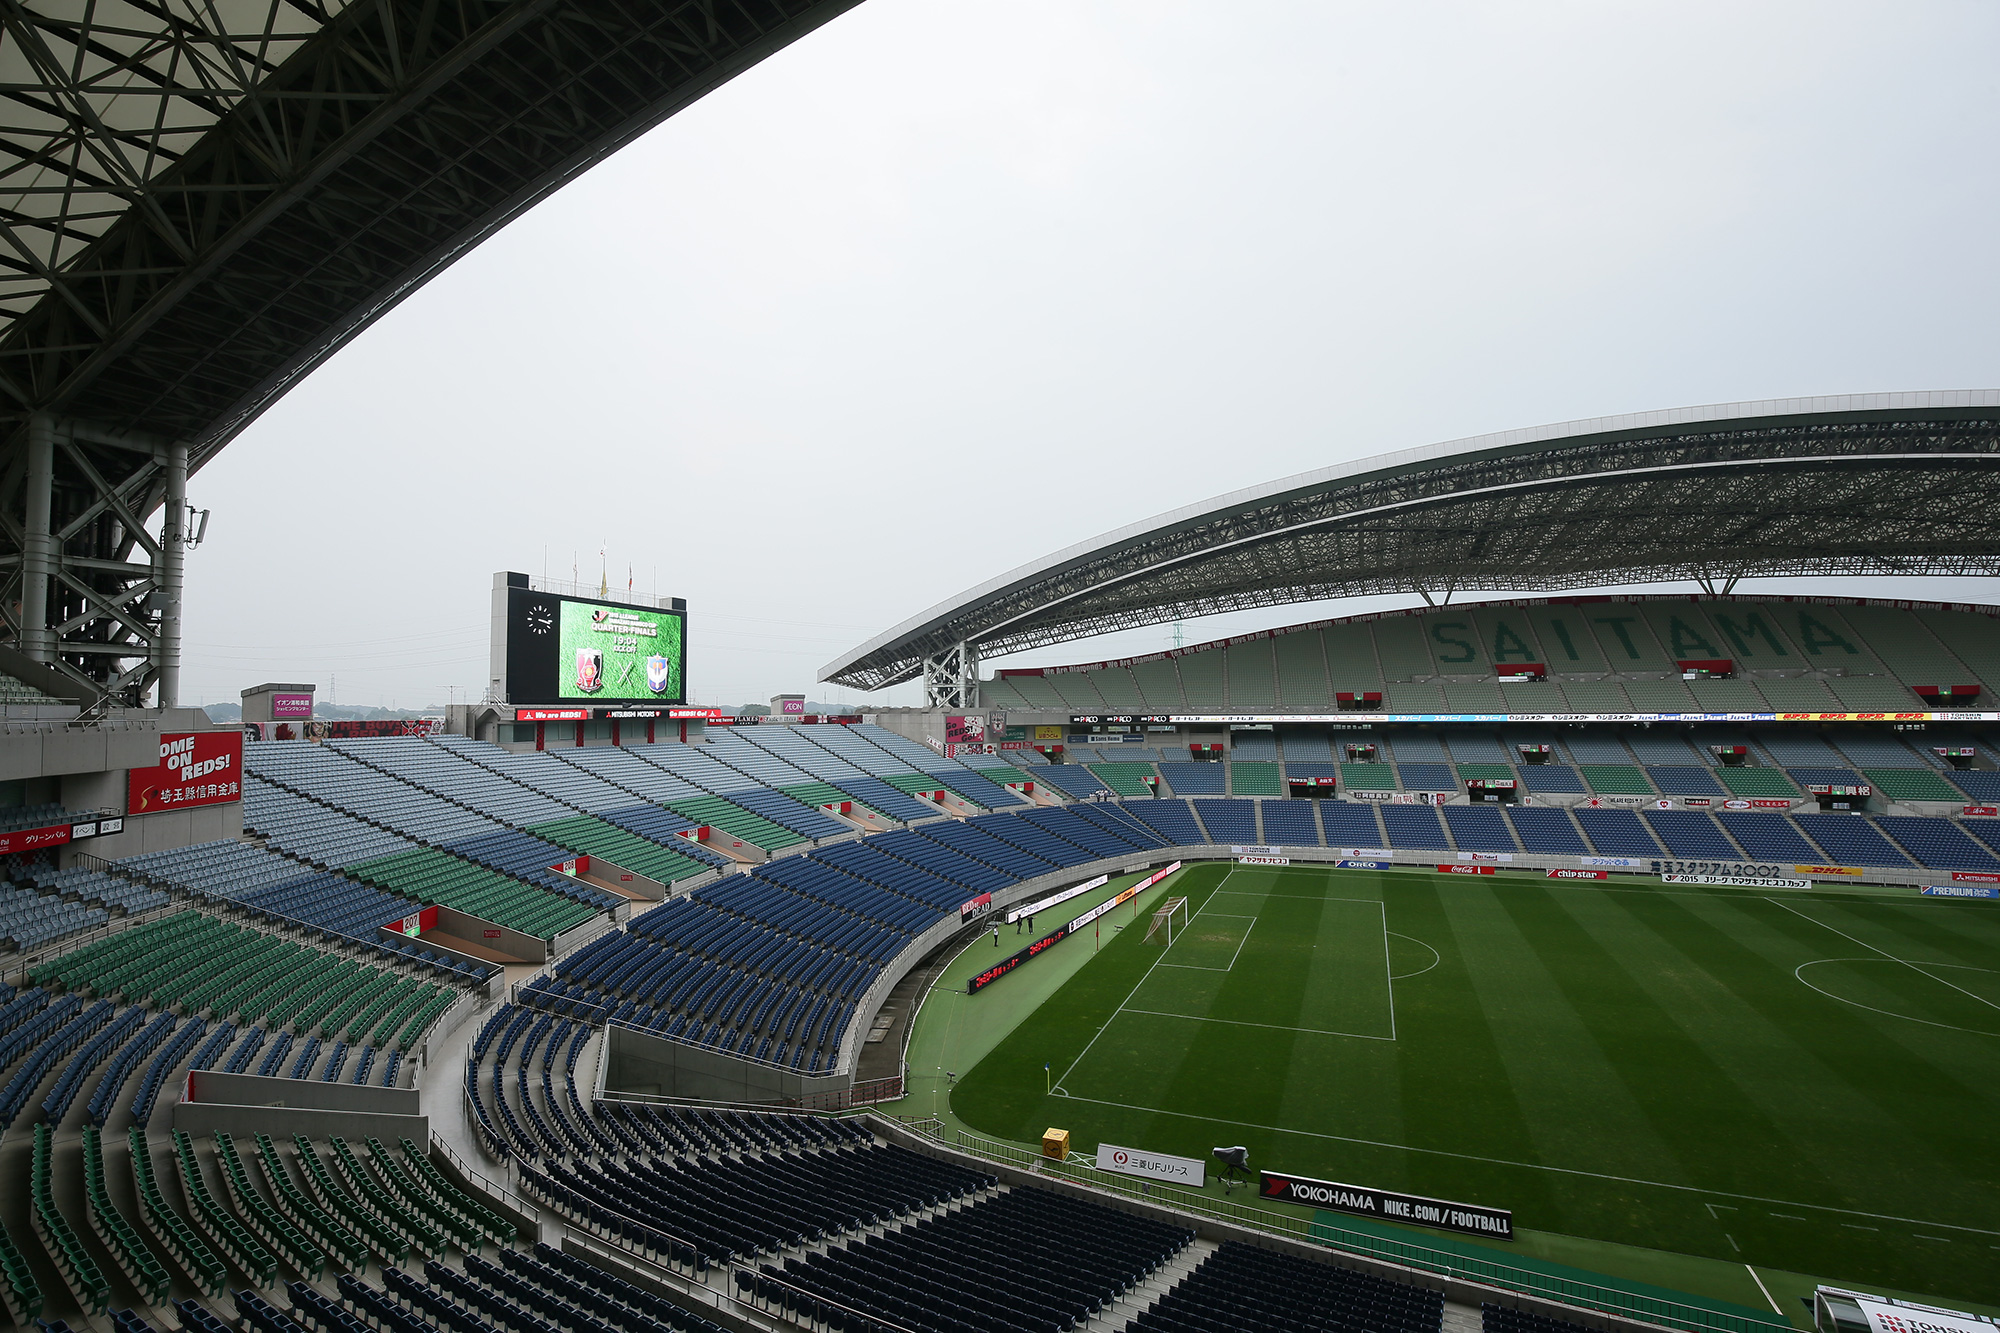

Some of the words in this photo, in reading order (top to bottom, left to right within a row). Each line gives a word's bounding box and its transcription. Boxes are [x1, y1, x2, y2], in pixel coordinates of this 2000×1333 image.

[1432, 611, 1860, 664] SAITAMA
[535, 711, 546, 719] We
[946, 722, 957, 730] Go
[948, 725, 974, 738] REDS!
[961, 733, 976, 742] Go!
[167, 751, 193, 770] ON
[181, 754, 231, 782] REDS!
[160, 782, 240, 804] 埼玉縣信用金庫
[74, 824, 96, 836] イベント
[1348, 861, 1377, 869] OREO
[1650, 860, 1780, 878] 埼玉スタジアム2002
[1811, 867, 1847, 875] DHL
[1680, 875, 1699, 883] 2015
[1704, 876, 1728, 884] Jリーグ
[1731, 878, 1786, 887] ヤマザキナビスコ
[1787, 880, 1808, 888] カップ
[1932, 886, 1974, 897] PREMIUM
[962, 900, 974, 914] RED
[972, 902, 990, 918] DEAD
[405, 915, 418, 929] 207
[1131, 1158, 1188, 1176] 三菱UFJリース
[1290, 1182, 1376, 1212] YOKOHAMA
